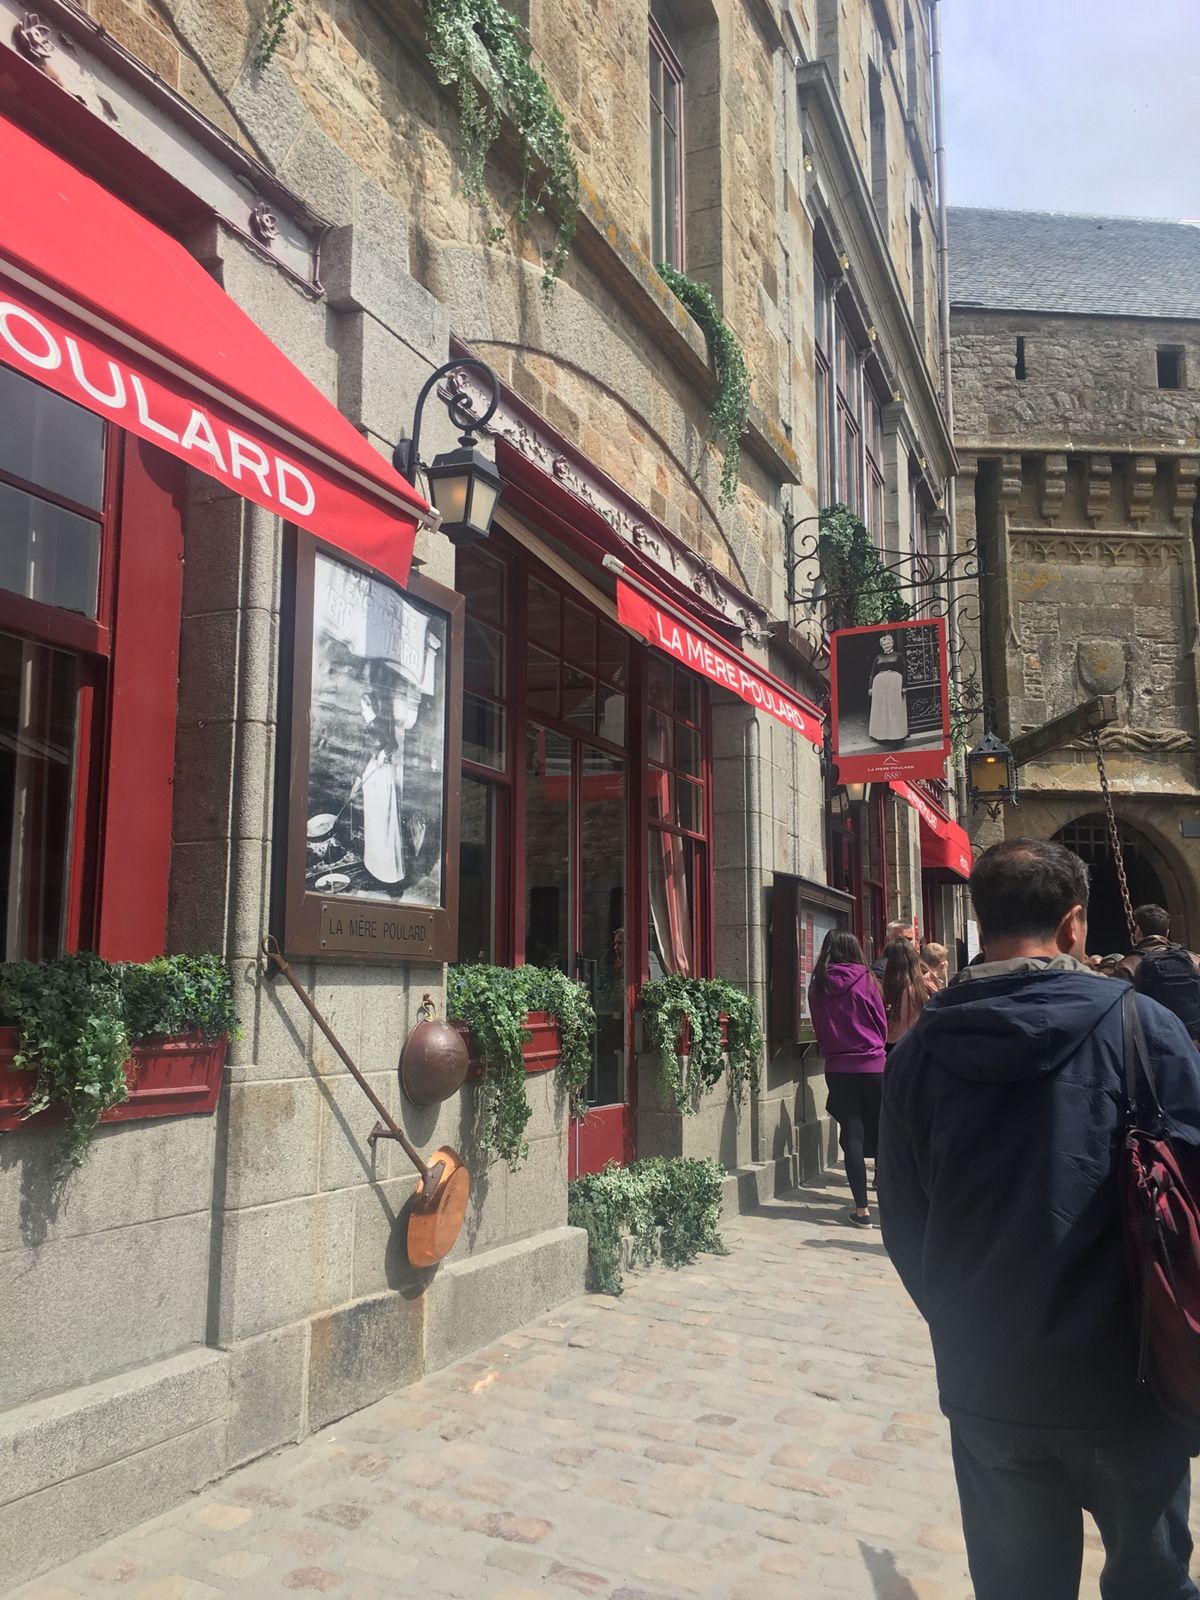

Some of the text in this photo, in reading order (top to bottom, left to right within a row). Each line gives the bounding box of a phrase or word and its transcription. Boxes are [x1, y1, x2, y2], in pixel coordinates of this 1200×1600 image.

[656, 612, 805, 731] LA MÈRE POULARD
[329, 914, 427, 942] LA MÈRE POULARD
